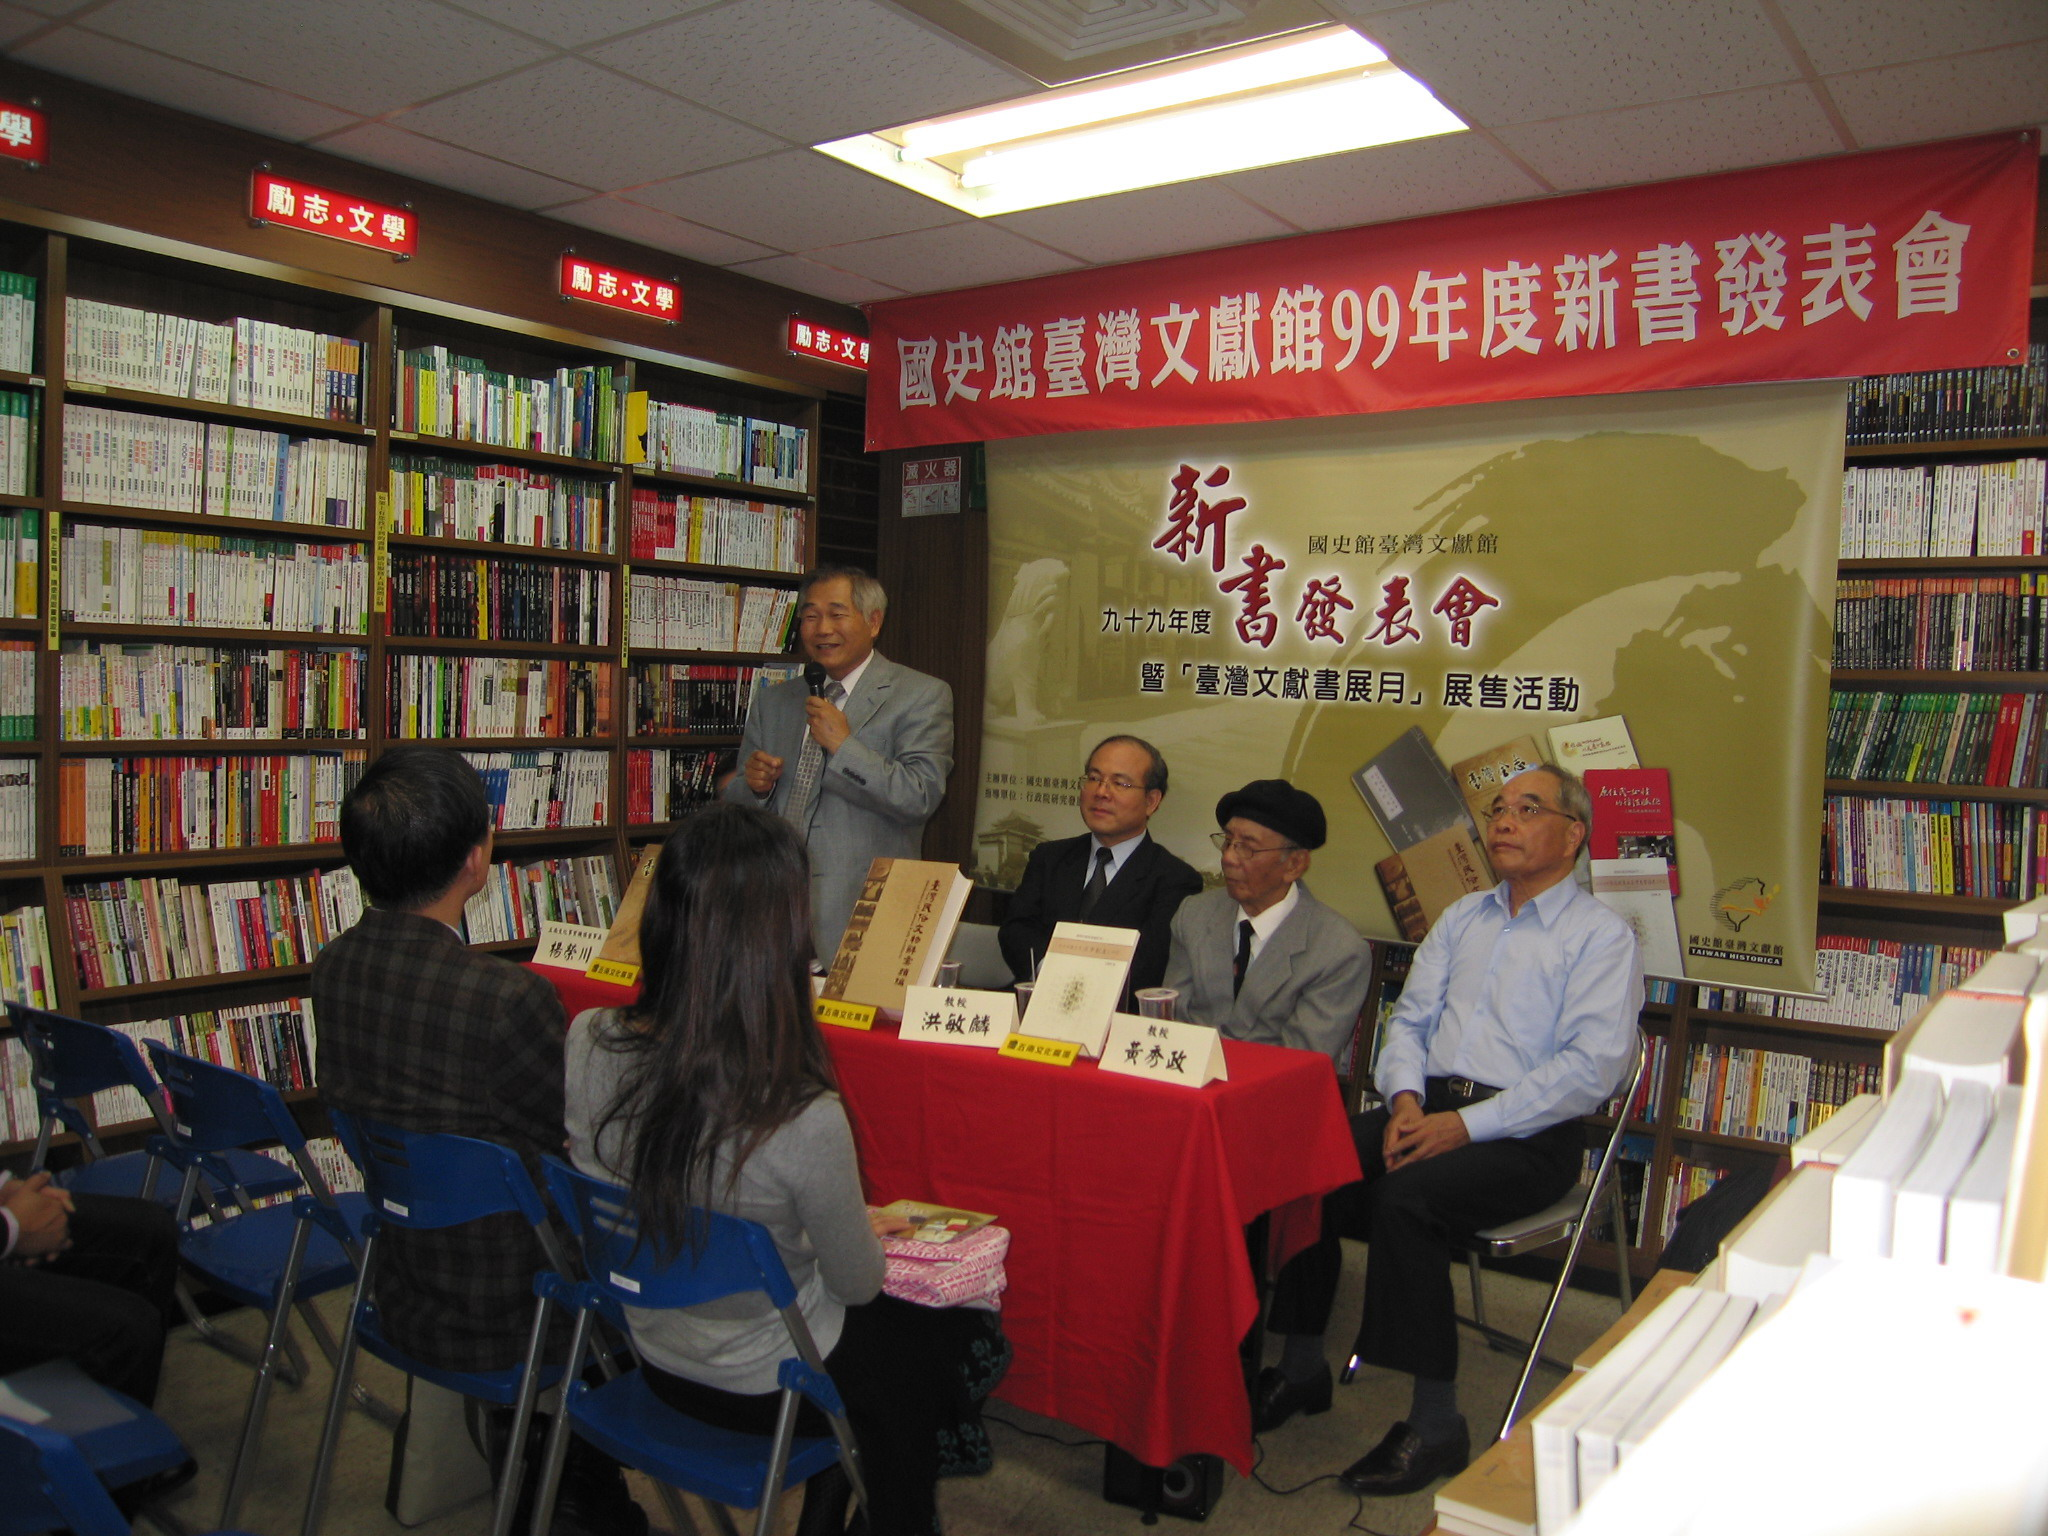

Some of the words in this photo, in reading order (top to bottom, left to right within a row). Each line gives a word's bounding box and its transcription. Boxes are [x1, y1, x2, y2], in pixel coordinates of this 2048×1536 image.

[0, 111, 33, 147] 學
[897, 210, 1971, 411] 國史館臺灣文獻館99年度新書發表會
[905, 460, 957, 481] 滅火器
[1308, 533, 1499, 556] 國史館臺灣文獻館
[1101, 608, 1212, 636] 九十九年度
[549, 941, 593, 963] 楊榮川
[1689, 933, 1783, 955] 國史館臺灣文獻館
[1691, 948, 1727, 959] TAIWAN
[1729, 952, 1780, 964] HISTORICA
[921, 1011, 991, 1037] 洪敏麟
